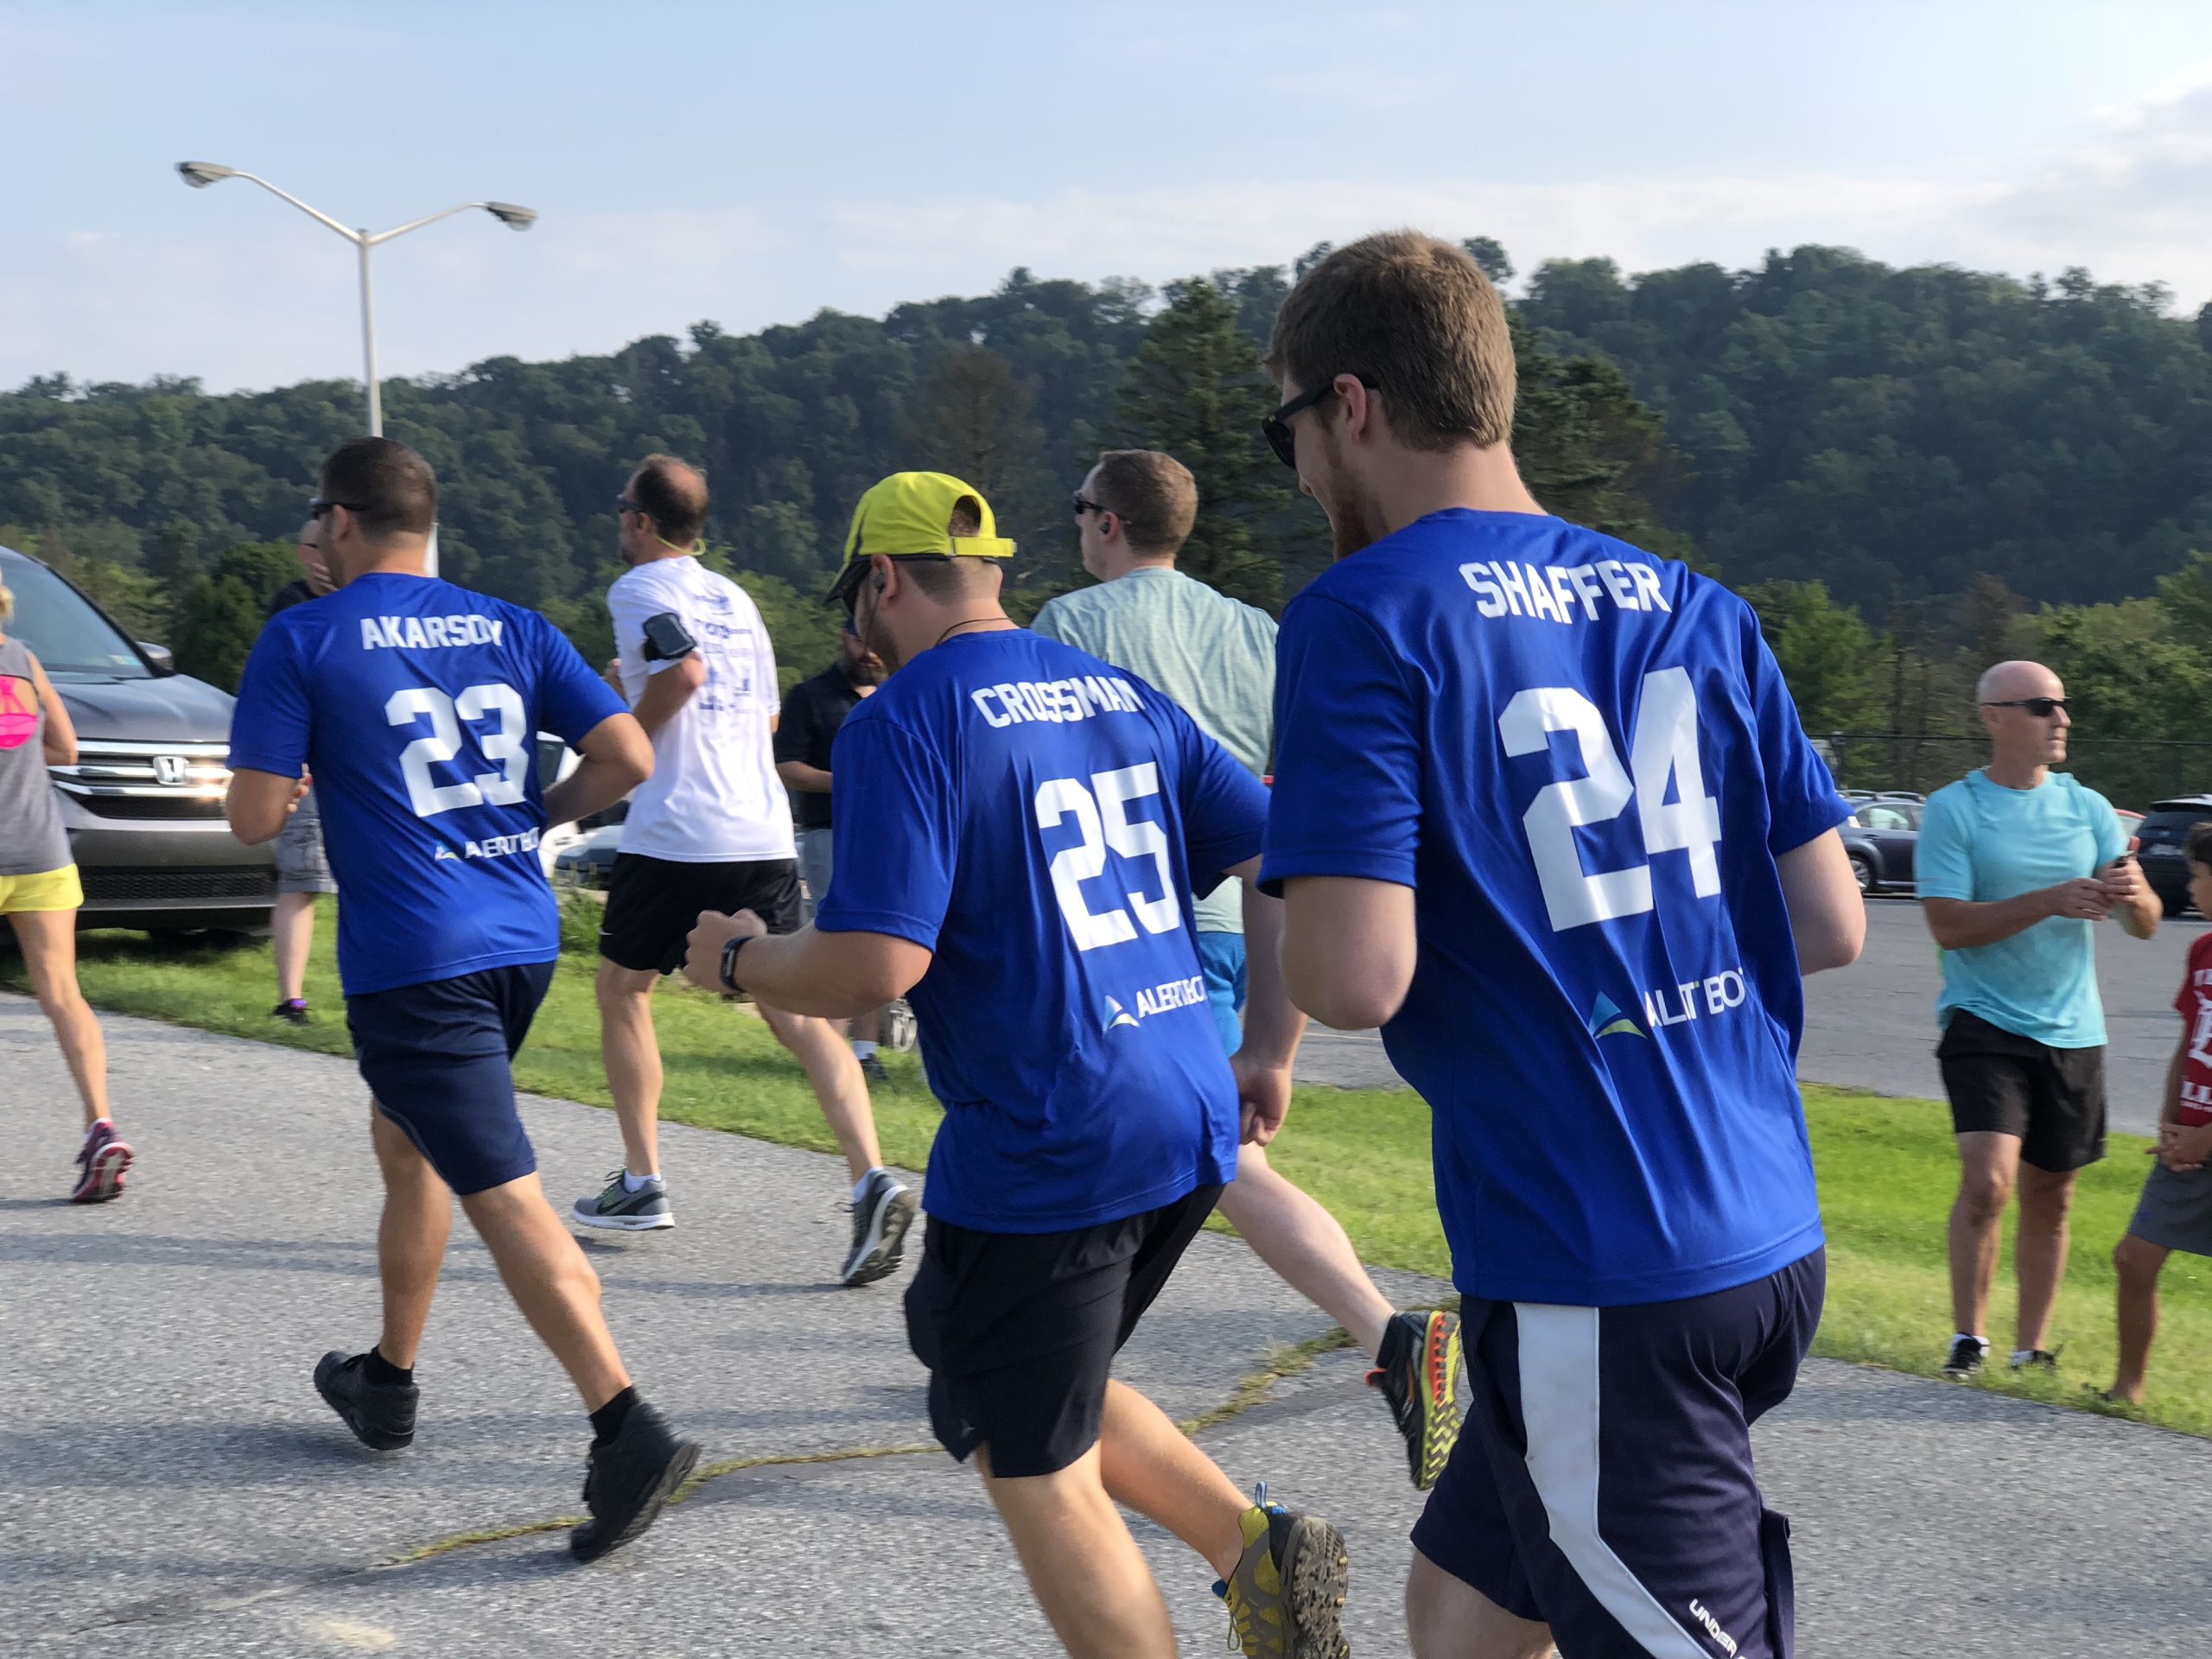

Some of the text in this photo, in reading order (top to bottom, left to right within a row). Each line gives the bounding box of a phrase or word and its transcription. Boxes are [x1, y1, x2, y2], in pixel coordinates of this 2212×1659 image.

[1459, 560, 1672, 625] SHAFFER
[360, 614, 503, 650] AKARSOY
[970, 676, 1147, 728] CROSSMAN
[385, 683, 529, 817] 23
[1498, 666, 1721, 932] 24
[1034, 761, 1181, 952] 25
[1688, 1598, 1738, 1659] UNDER
